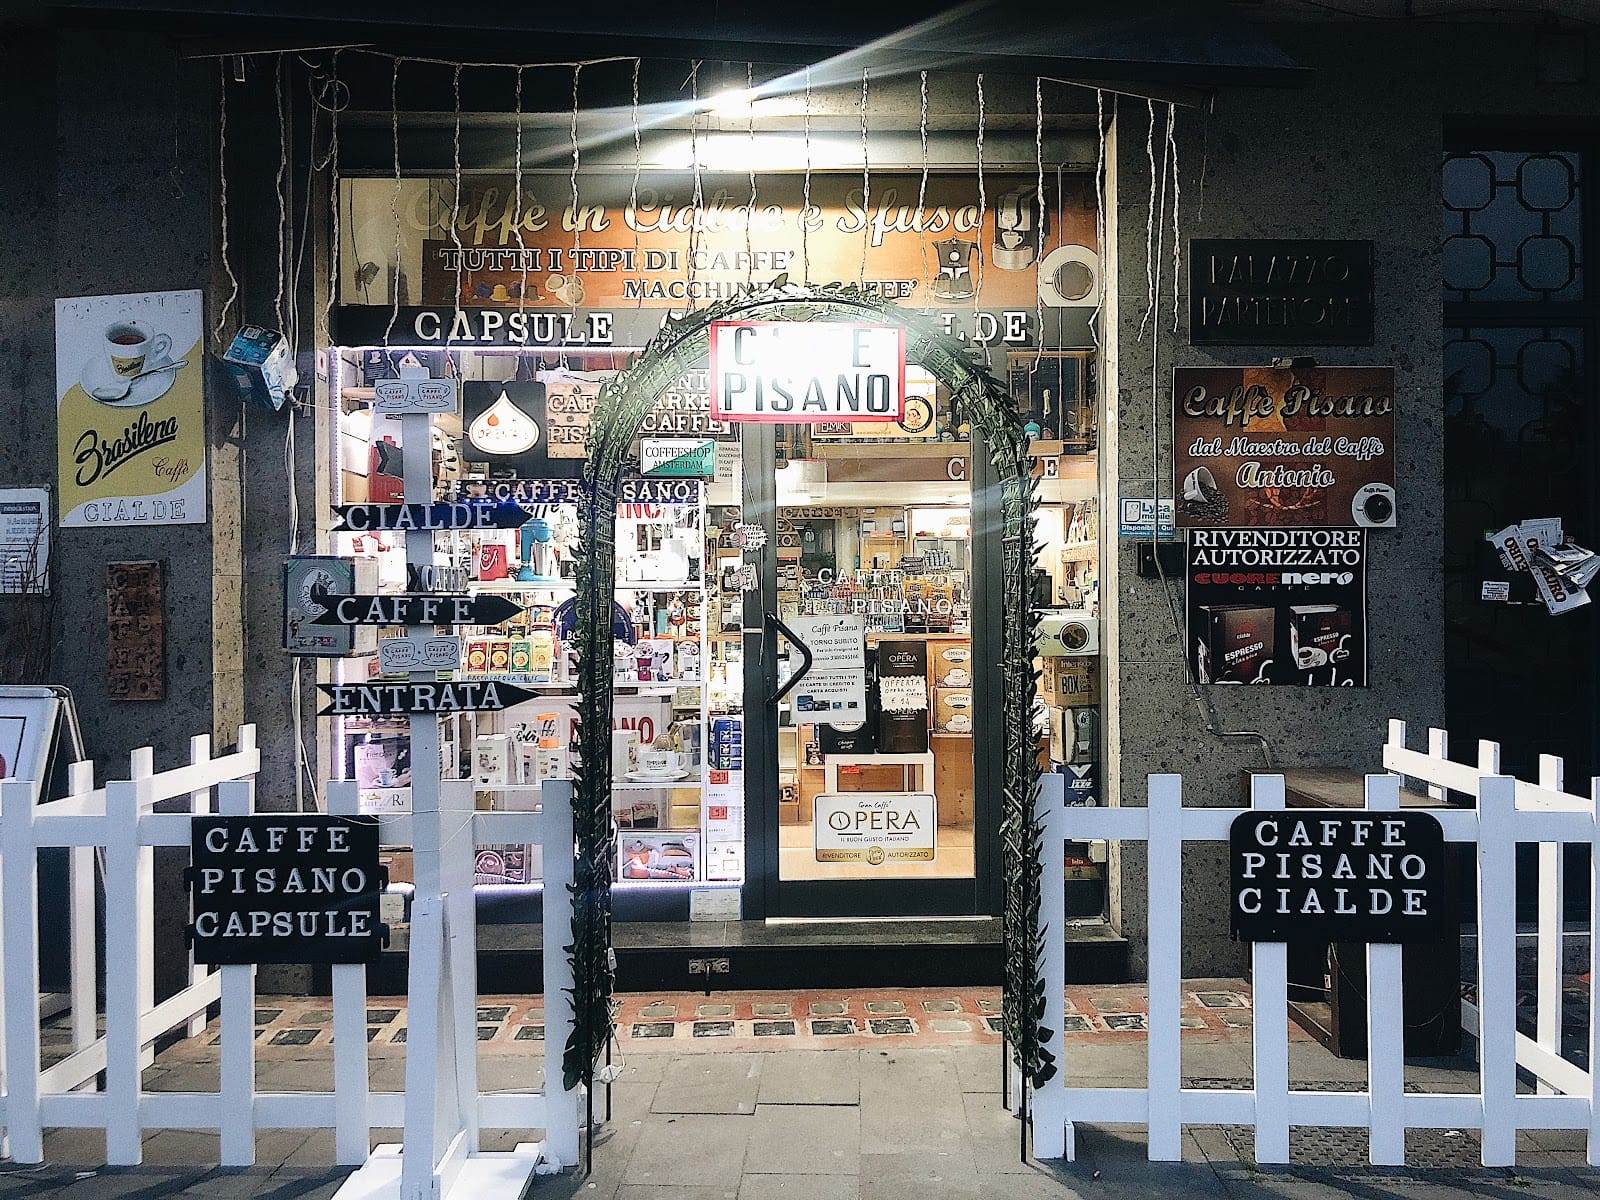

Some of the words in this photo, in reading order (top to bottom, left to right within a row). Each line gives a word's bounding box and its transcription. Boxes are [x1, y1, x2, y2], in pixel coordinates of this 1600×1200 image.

[406, 186, 548, 246] Caffè
[562, 193, 610, 233] in
[624, 188, 785, 234] Cialde
[797, 203, 824, 233] e
[837, 187, 982, 248] Sfuso
[439, 248, 542, 272] TUTTI
[548, 248, 565, 272] I
[569, 248, 636, 272] TIPI
[644, 248, 680, 272] DI
[691, 249, 795, 271] CAFFE'
[414, 310, 614, 344] CAPSULE
[724, 371, 890, 413] PISANO
[1184, 384, 1275, 425] Caffè
[1282, 384, 1393, 418] Pisano
[641, 413, 723, 432] CAFFE
[72, 411, 179, 487] Brasilena
[645, 446, 711, 458] COFFEESHOP
[1188, 437, 1222, 457] dal
[1224, 437, 1300, 457] Maestro
[1302, 436, 1332, 457] del
[1333, 437, 1385, 461] Caffè
[152, 455, 191, 483] Caffè
[653, 460, 703, 470] AMSTERDAM
[1235, 461, 1336, 489] Antonio
[495, 483, 580, 500] CAFFE
[622, 483, 691, 501] SANO
[83, 498, 187, 522] CIALDE
[345, 502, 498, 531] CIALDE
[1192, 530, 1361, 547] RIVENDITORE
[1191, 549, 1361, 566] AUTORIZZATO
[336, 597, 476, 624] CAFFE
[852, 599, 953, 615] PISANO
[834, 637, 859, 645] SUBITO
[1224, 641, 1264, 662] ESPRESSO
[888, 654, 918, 663] OPERA
[331, 682, 505, 714] ENTRATA
[1061, 675, 1079, 695] BOX
[828, 809, 921, 831] OPERA
[205, 826, 351, 854] CAFFE
[1254, 820, 1406, 847] CAFFE
[1241, 852, 1426, 880] PISANO
[200, 867, 368, 894] PISANO
[1238, 887, 1428, 916] CIALDE
[195, 910, 372, 937] CAPSULE
